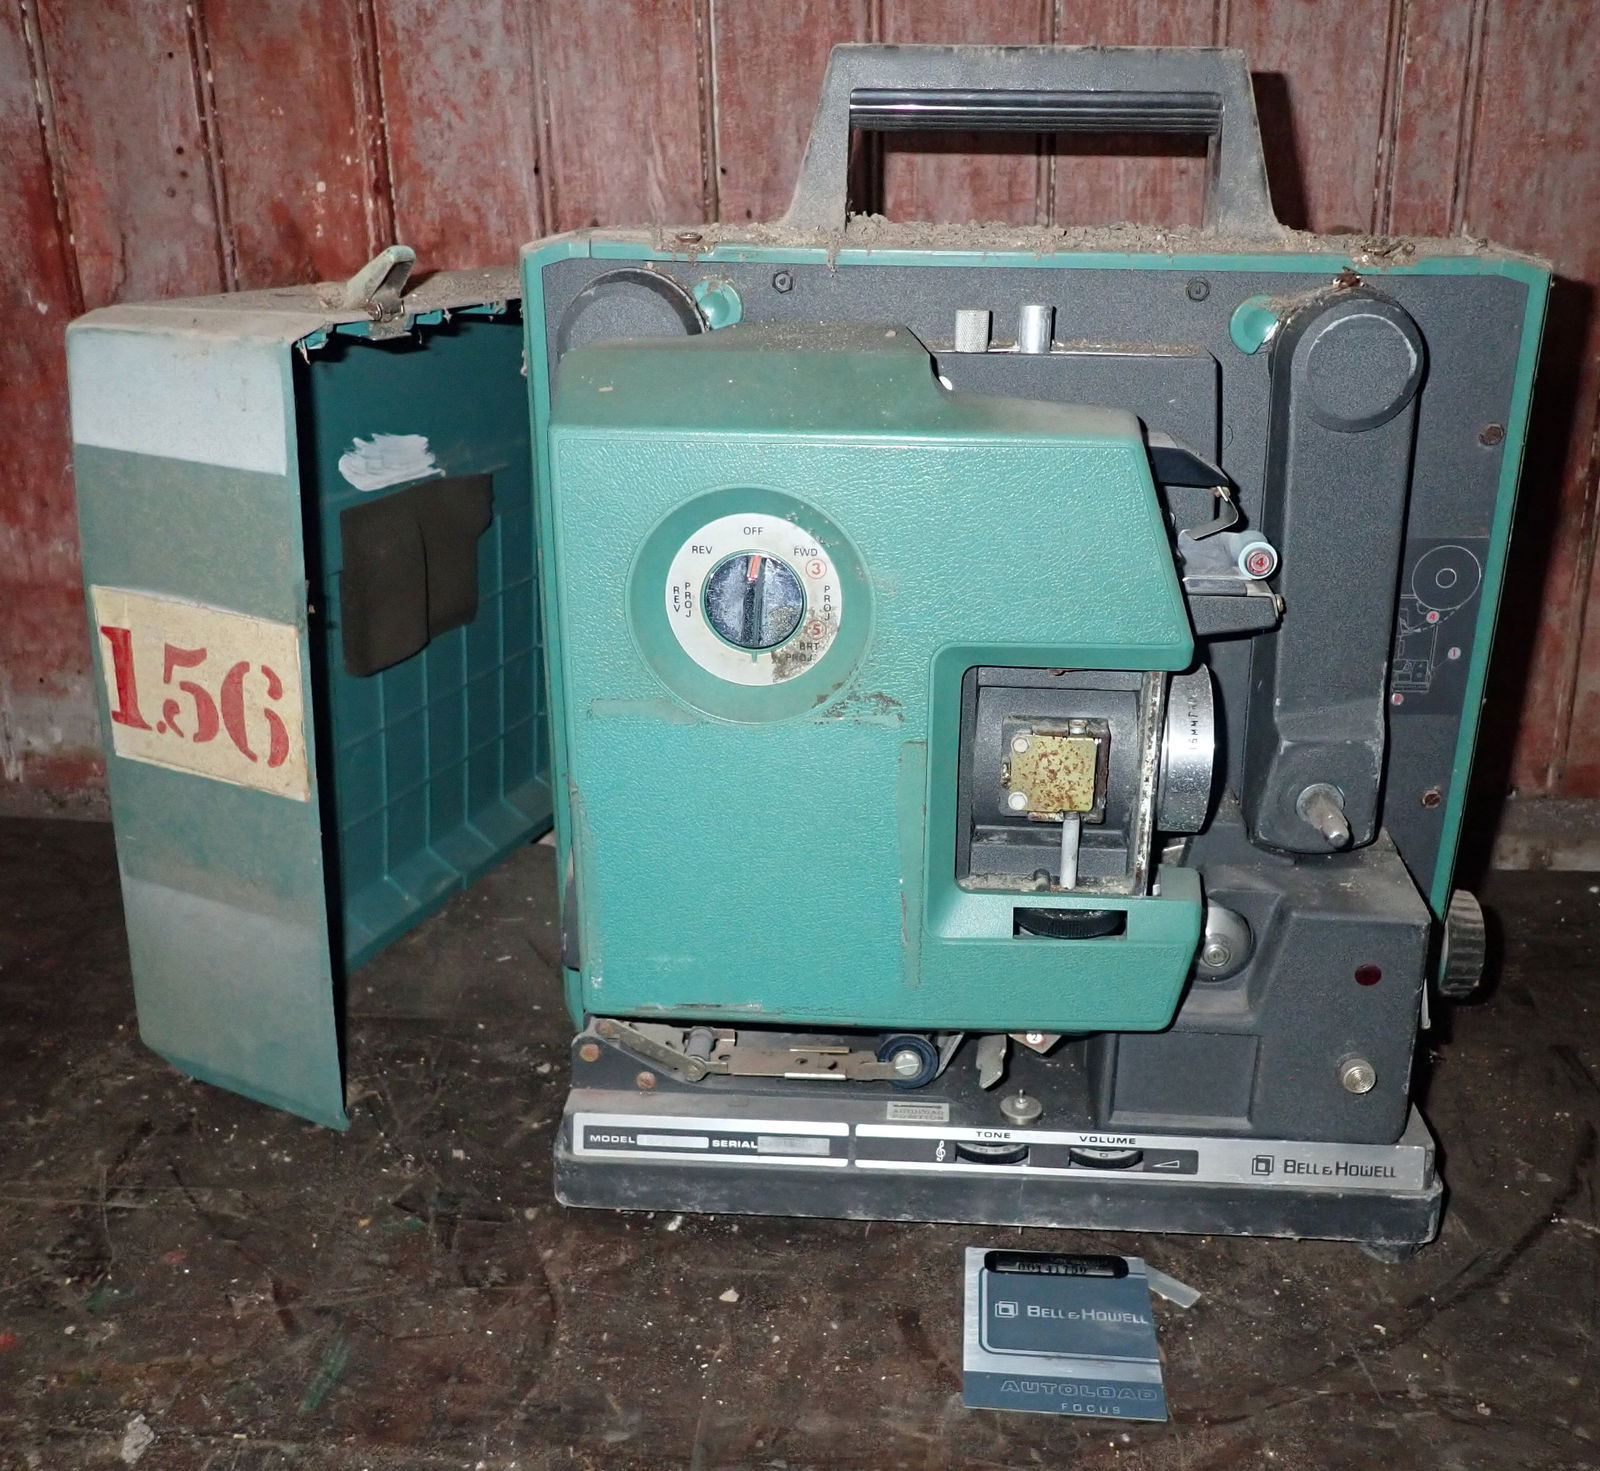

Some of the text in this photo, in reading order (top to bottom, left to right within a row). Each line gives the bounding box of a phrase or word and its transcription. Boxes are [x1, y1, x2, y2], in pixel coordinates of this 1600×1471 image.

[742, 526, 764, 536] OFF
[691, 545, 713, 555] REV
[793, 547, 818, 557] FWD
[811, 562, 822, 575] 3
[673, 585, 681, 613] REV
[684, 581, 693, 618] PROJ
[824, 585, 832, 620] PROJ
[799, 641, 820, 651] BRT
[590, 1134, 758, 1149] MODEL SERIAL
[975, 1130, 1012, 1140] TONE
[1079, 1135, 1137, 1146] VOLUME
[1000, 1379, 1158, 1401] AUTOLOAD
[1061, 1402, 1121, 1415] FOCUS
